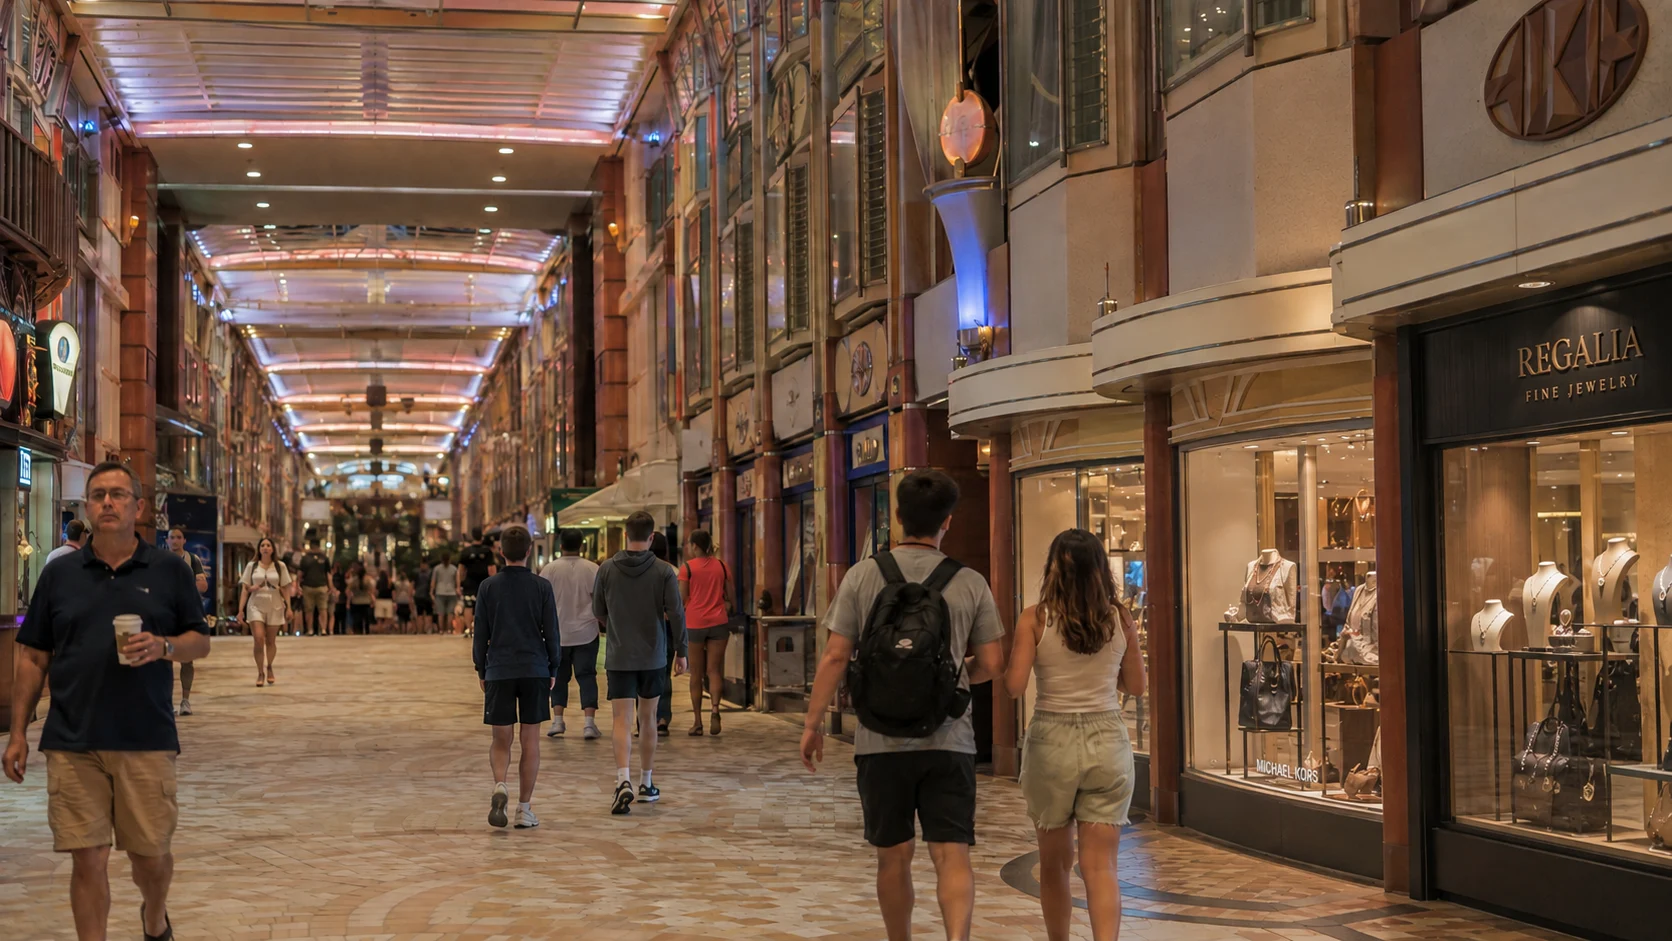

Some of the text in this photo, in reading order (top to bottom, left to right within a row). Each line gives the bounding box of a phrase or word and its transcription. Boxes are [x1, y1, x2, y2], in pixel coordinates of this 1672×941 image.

[1517, 325, 1644, 378] REGALIA
[1525, 373, 1638, 402] FINE JEWELRY
[1256, 758, 1318, 783] MICHAEL KORS
